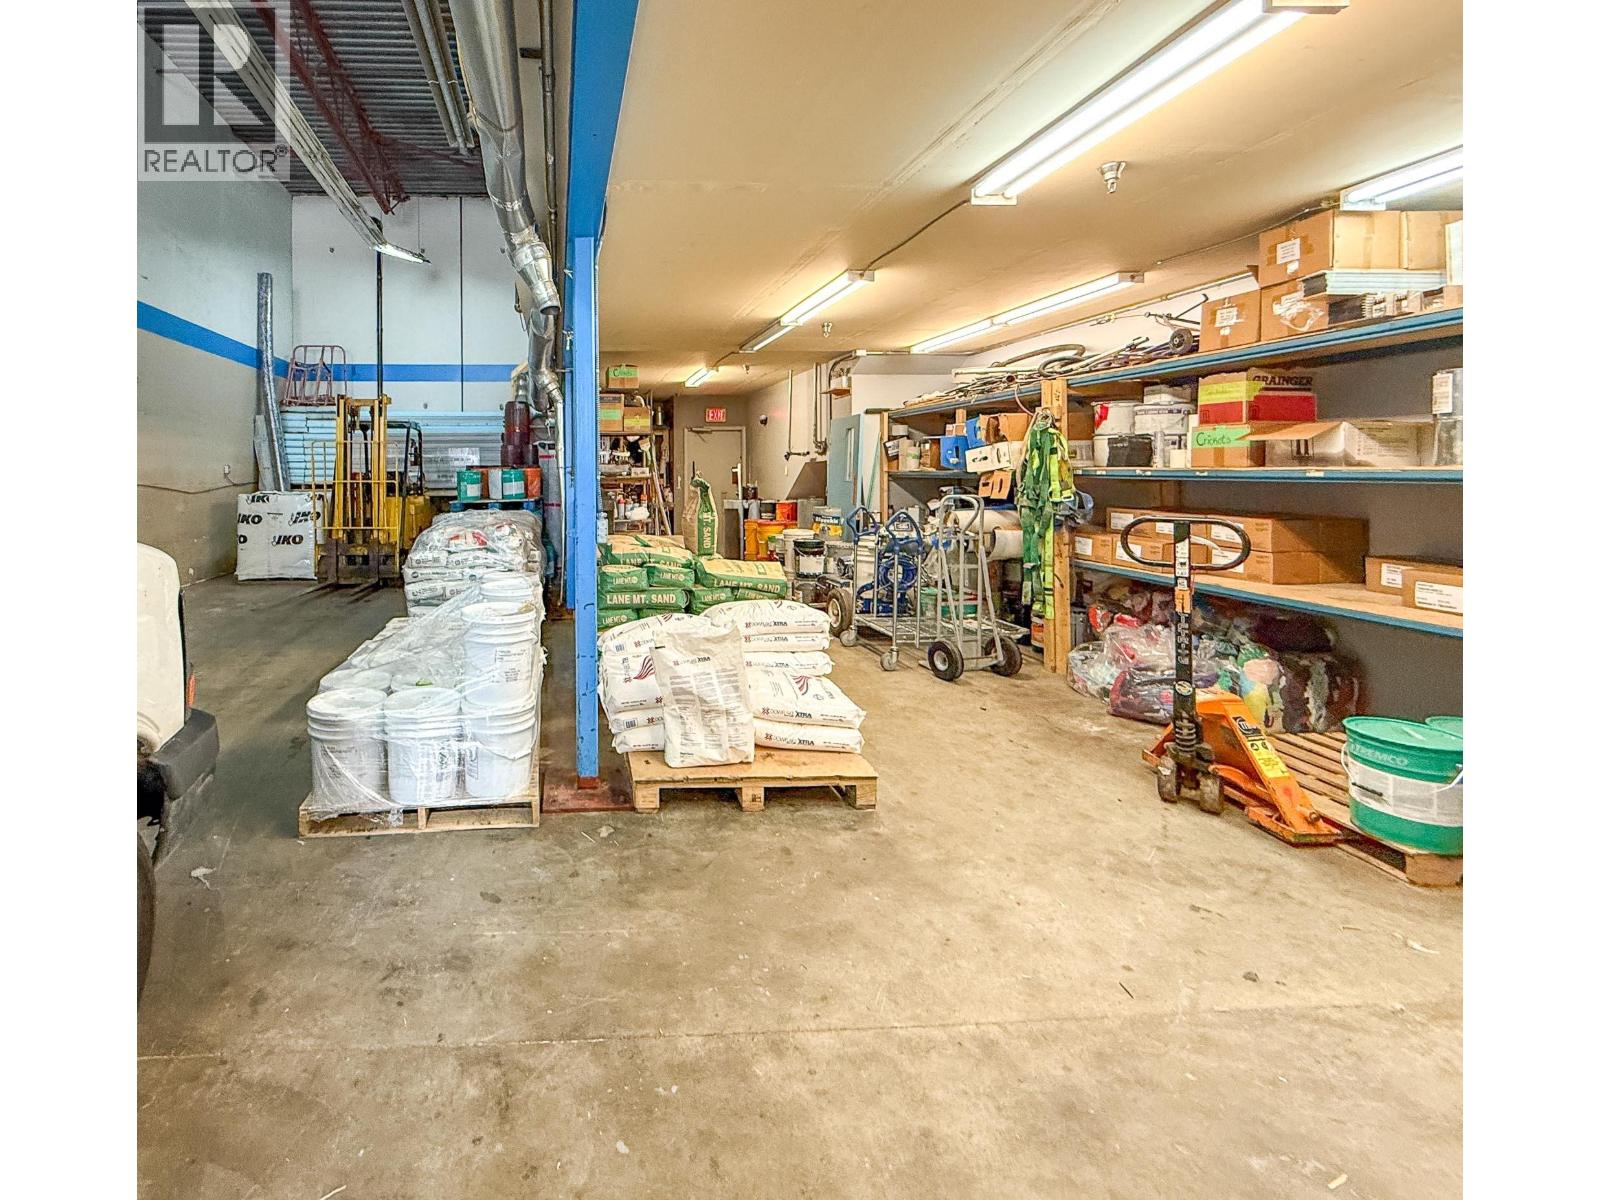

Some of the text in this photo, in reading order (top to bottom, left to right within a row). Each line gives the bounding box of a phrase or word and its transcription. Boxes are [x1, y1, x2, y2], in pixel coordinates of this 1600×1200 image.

[1253, 375, 1313, 386] GRAINGER
[708, 408, 725, 421] EXIT
[238, 513, 263, 525] IKO
[276, 534, 304, 545] IKO
[703, 527, 711, 549] SAND
[606, 594, 677, 604] LANE MT. SAND
[795, 710, 812, 719] XTRA
[798, 737, 815, 746] XTRA
